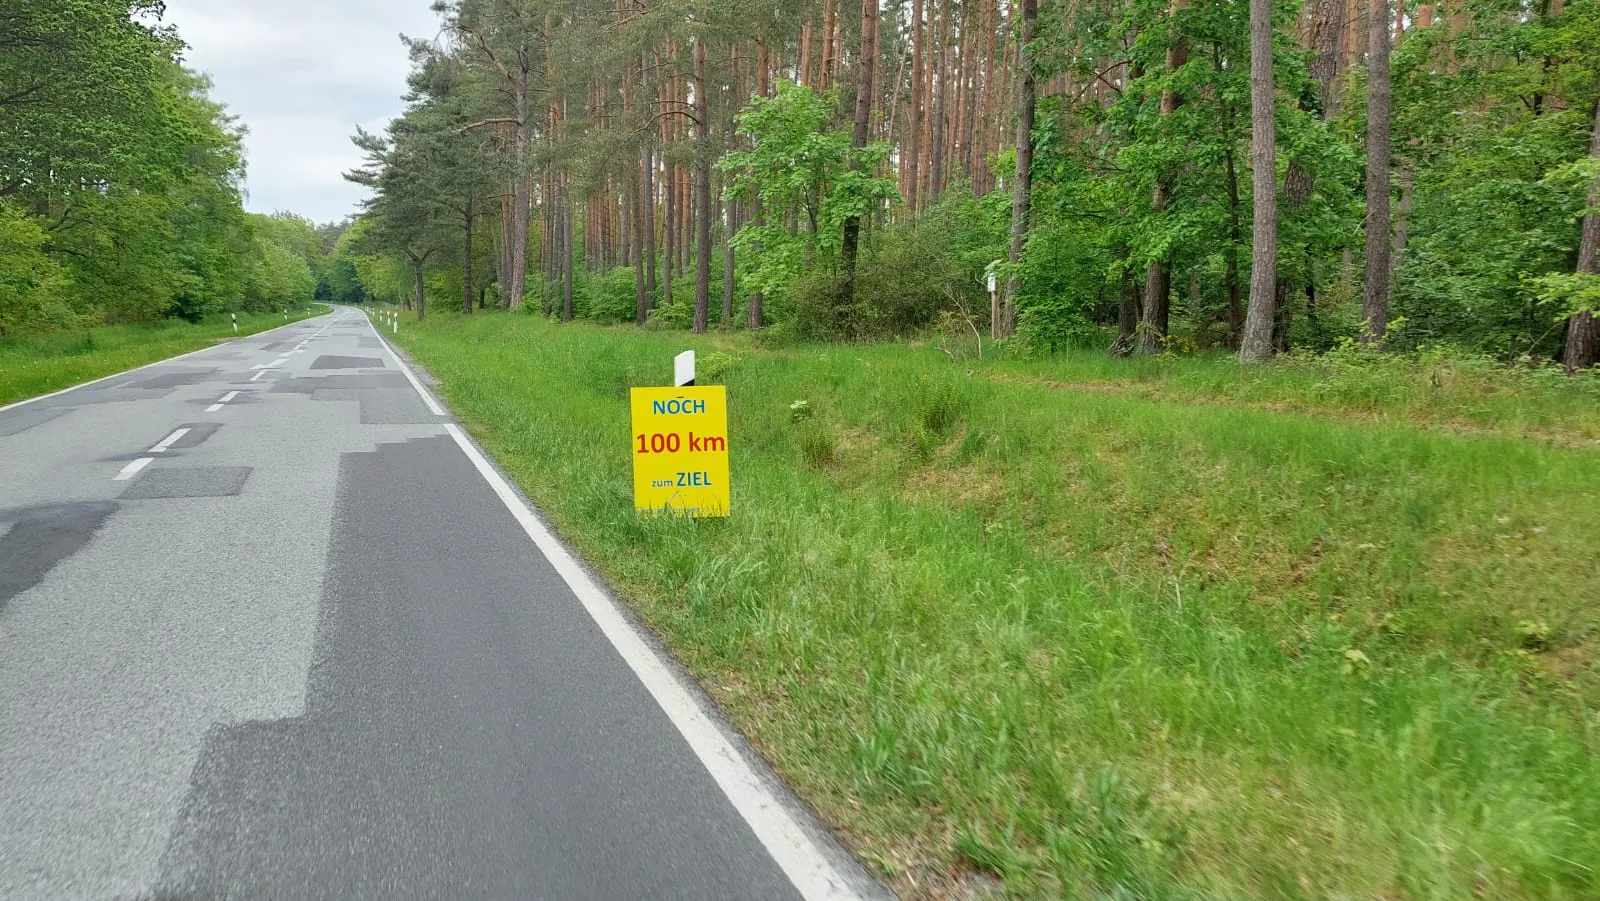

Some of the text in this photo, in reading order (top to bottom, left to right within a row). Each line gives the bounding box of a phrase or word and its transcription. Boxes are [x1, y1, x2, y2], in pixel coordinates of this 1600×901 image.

[653, 399, 705, 415] NOCH
[637, 432, 725, 454] 100 km
[652, 472, 711, 488] zum ZIEL
